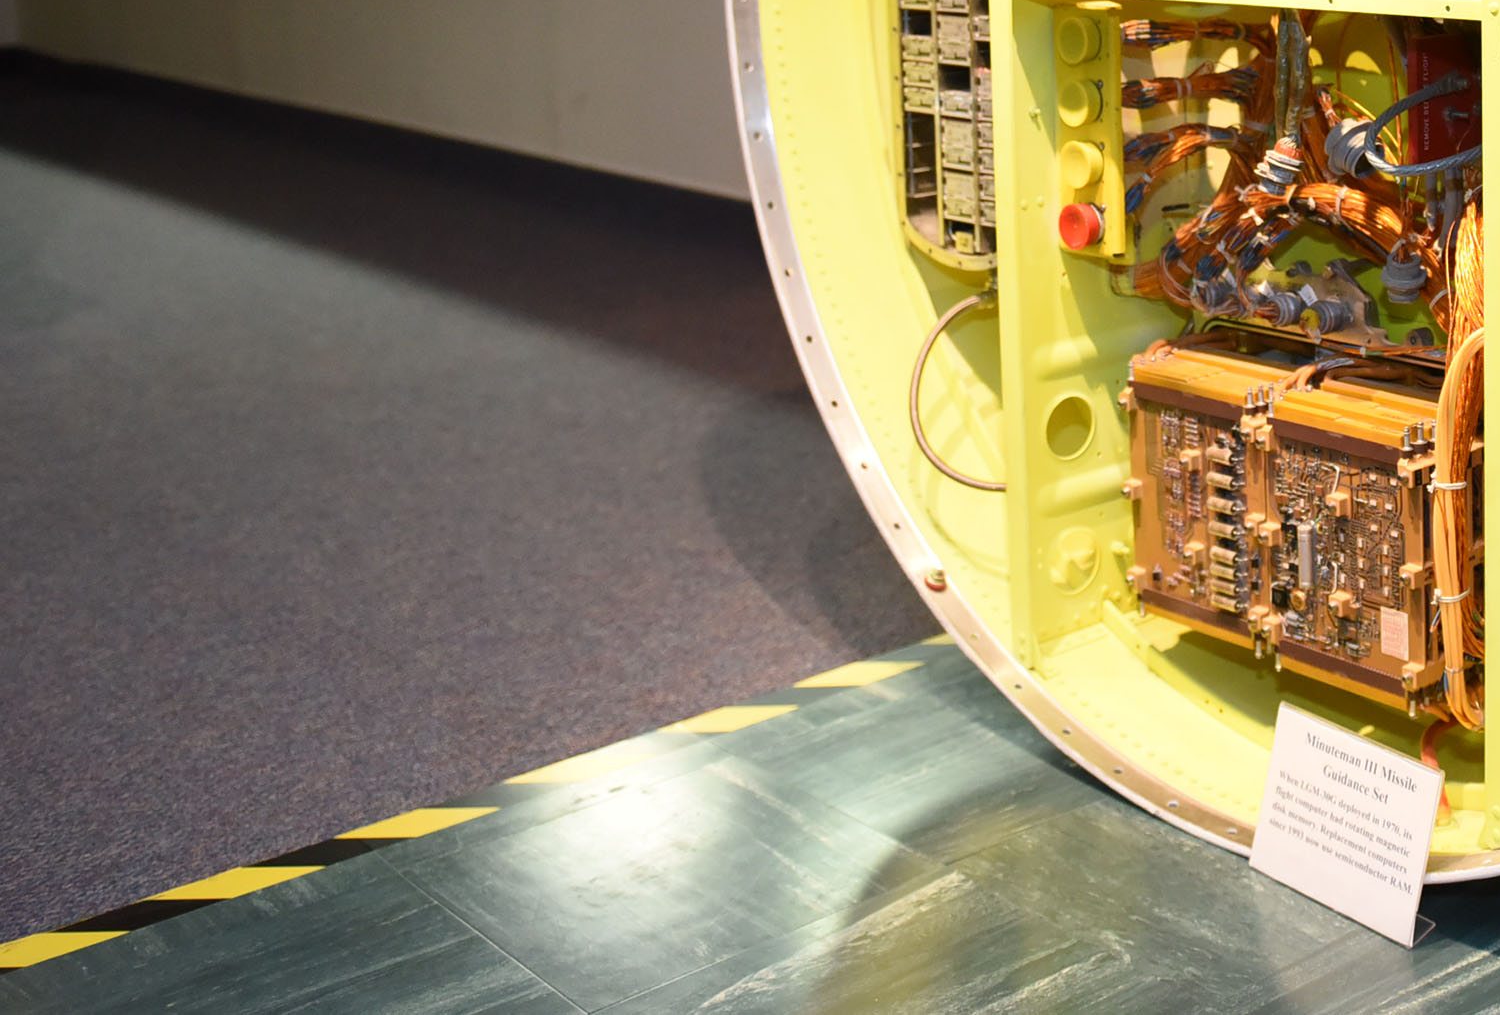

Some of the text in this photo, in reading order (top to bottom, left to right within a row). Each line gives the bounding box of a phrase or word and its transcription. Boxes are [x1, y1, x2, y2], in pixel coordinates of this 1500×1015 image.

[1306, 732, 1418, 793] Minuteman III Missile
[1323, 764, 1389, 804] Guidance Set
[1271, 800, 1286, 814] disk
[1319, 824, 1366, 856] Replacement
[1367, 848, 1407, 876] computers
[1274, 785, 1410, 859] flight computer had rotating magnetic
[1279, 770, 1299, 786] When
[1337, 798, 1370, 823] deployed
[1372, 814, 1380, 825] in
[1381, 818, 1402, 837] 1970,
[1402, 828, 1413, 841] its
[1268, 816, 1286, 831] since
[1305, 836, 1319, 848] now
[1321, 843, 1333, 855] use
[1334, 848, 1387, 882] semiconductor
[1389, 875, 1413, 895] RAM.
